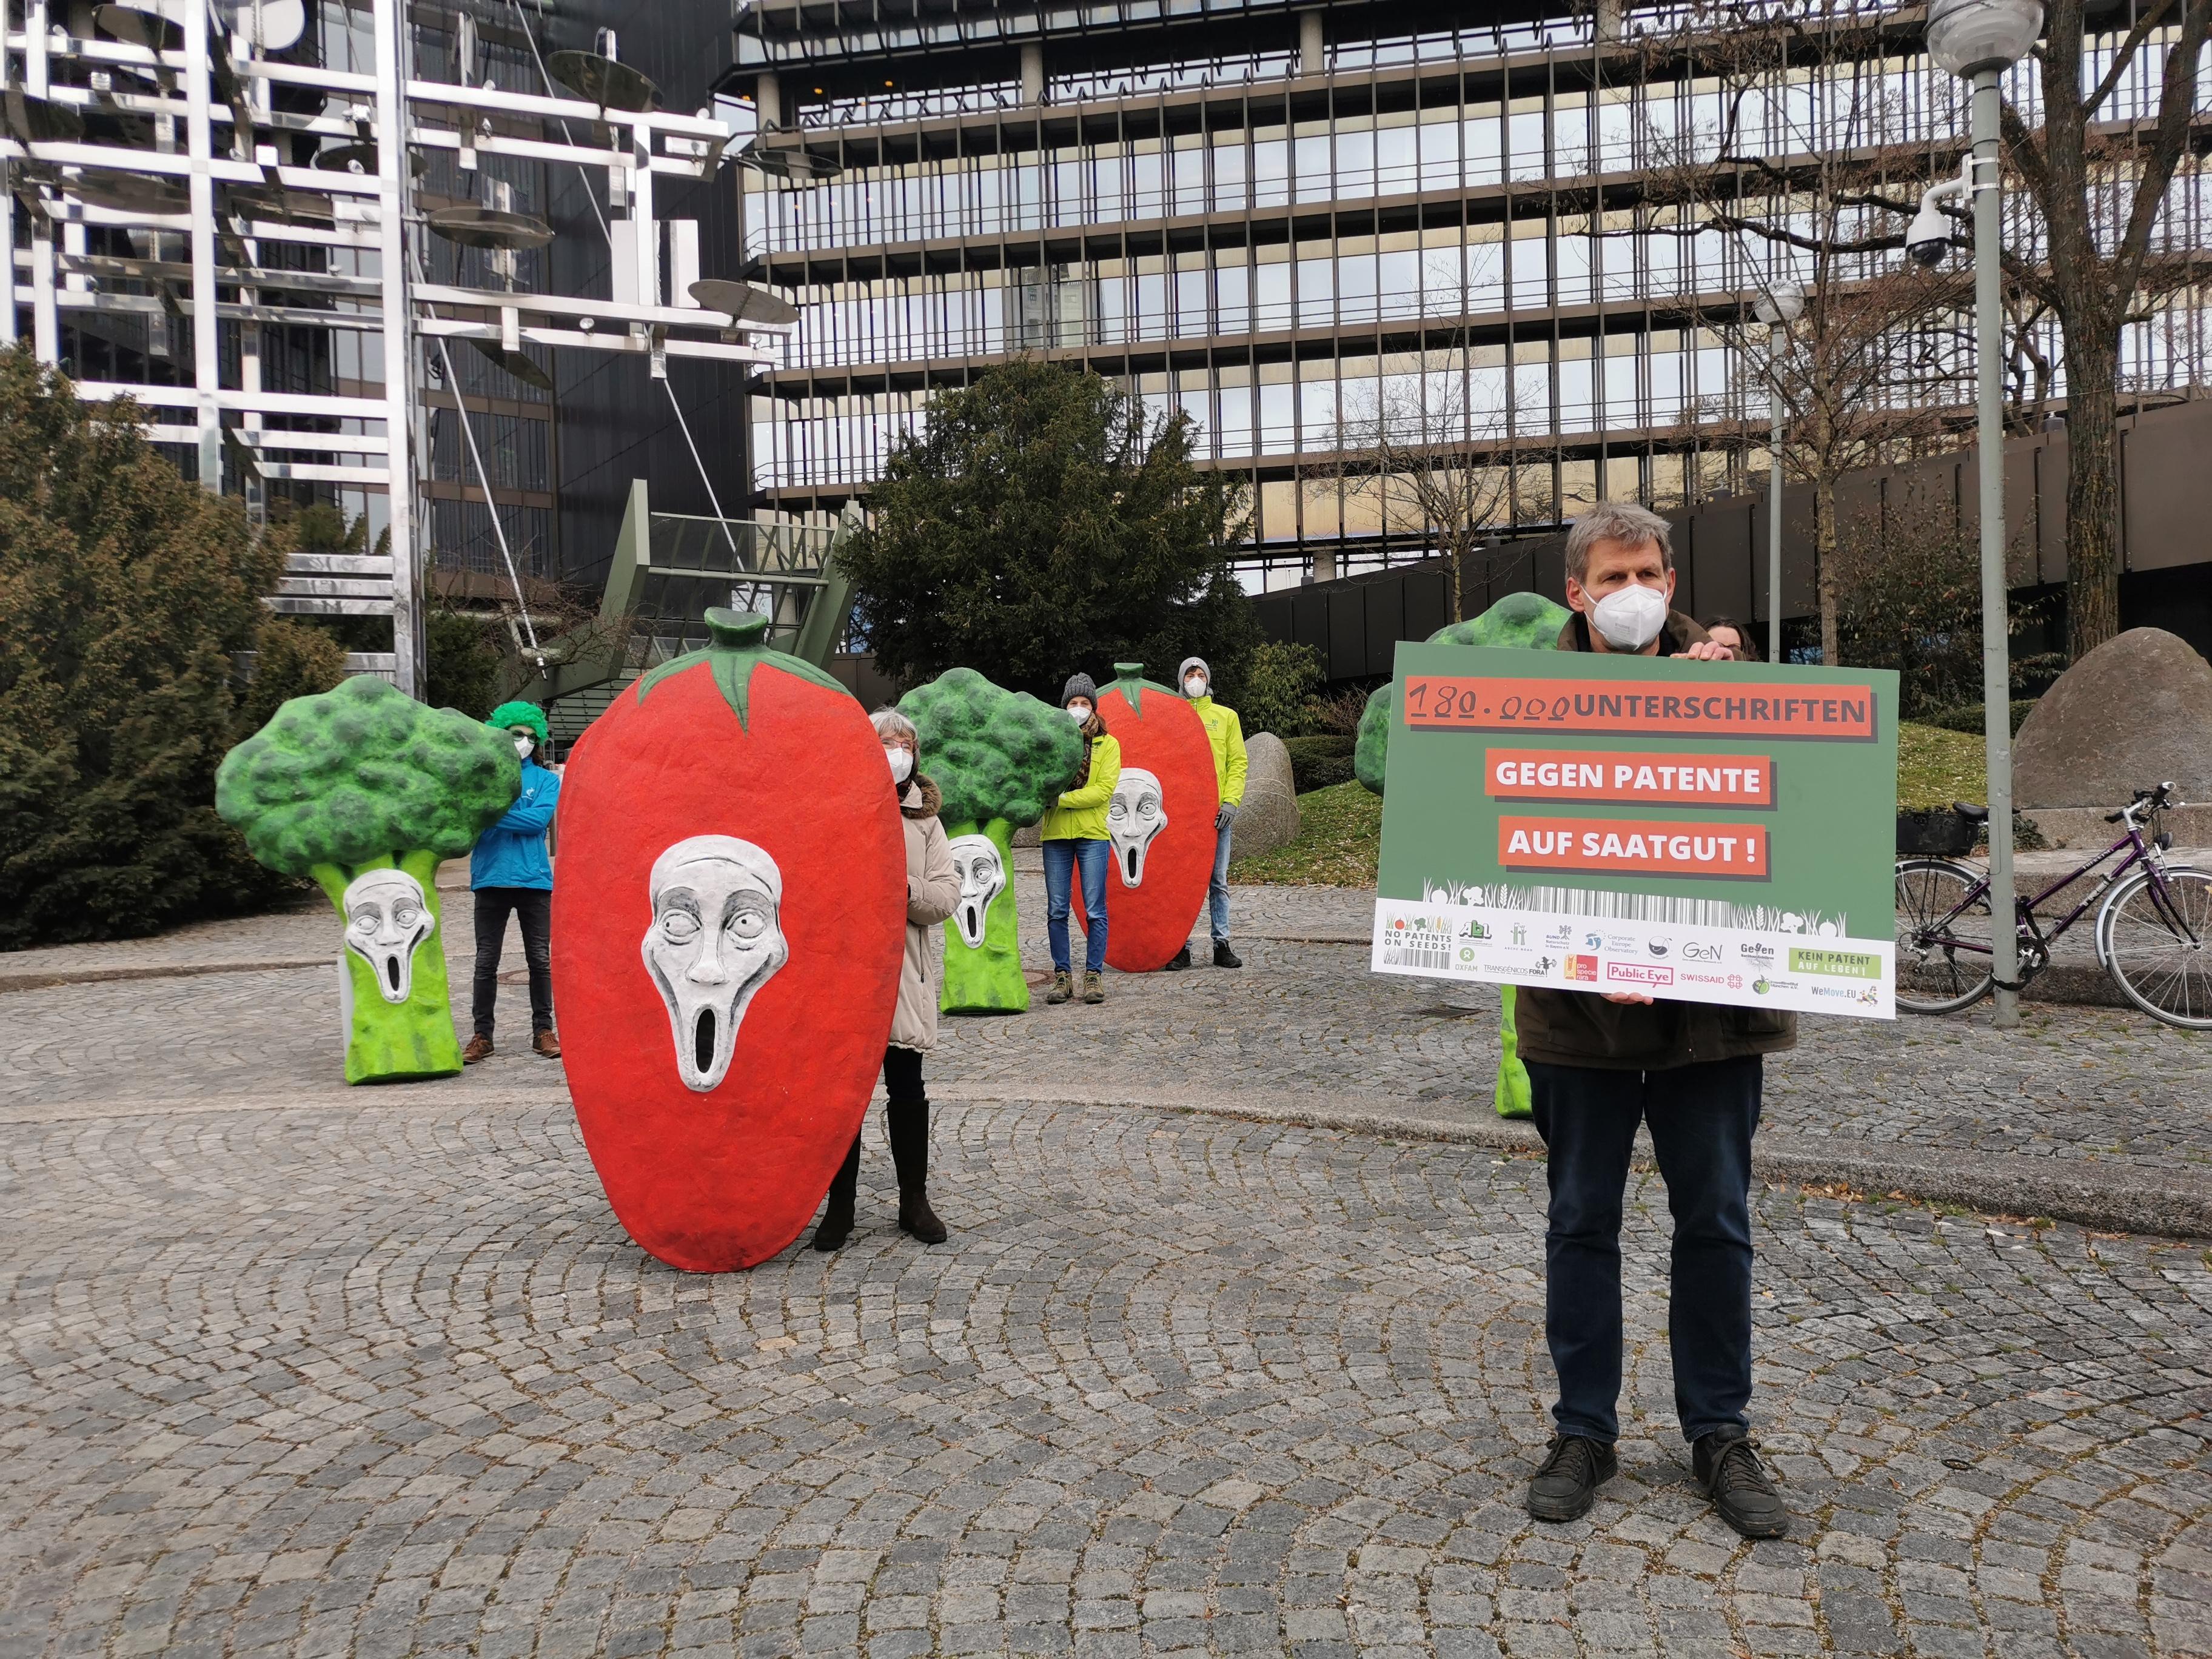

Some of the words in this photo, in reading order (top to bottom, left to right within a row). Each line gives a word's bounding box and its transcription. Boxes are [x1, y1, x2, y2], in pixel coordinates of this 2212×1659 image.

[1574, 694, 1865, 723] UNTERSCHRIFTEN
[1496, 762, 1603, 788] GEGEN
[1615, 765, 1760, 793] PATENTE
[1507, 830, 1572, 855] AUF
[1582, 833, 1737, 862] SAATGUT
[1405, 931, 1452, 942] PATENTS
[1409, 940, 1452, 951] SEEDS!
[1604, 946, 1638, 956] Observatory
[1683, 942, 1723, 960] GeN
[1741, 942, 1774, 955] Gegen
[1798, 951, 1823, 961] KEIN
[1828, 954, 1871, 965] PATENT
[1455, 964, 1478, 973] OXFAM
[1483, 964, 1529, 974] TRANSGÉNICOS
[1798, 961, 1818, 970] AUF
[1611, 966, 1645, 980] Public
[1647, 970, 1669, 987] Eye
[1680, 973, 1724, 984] SWISSAID
[1811, 986, 1856, 999] WeMove.EU
